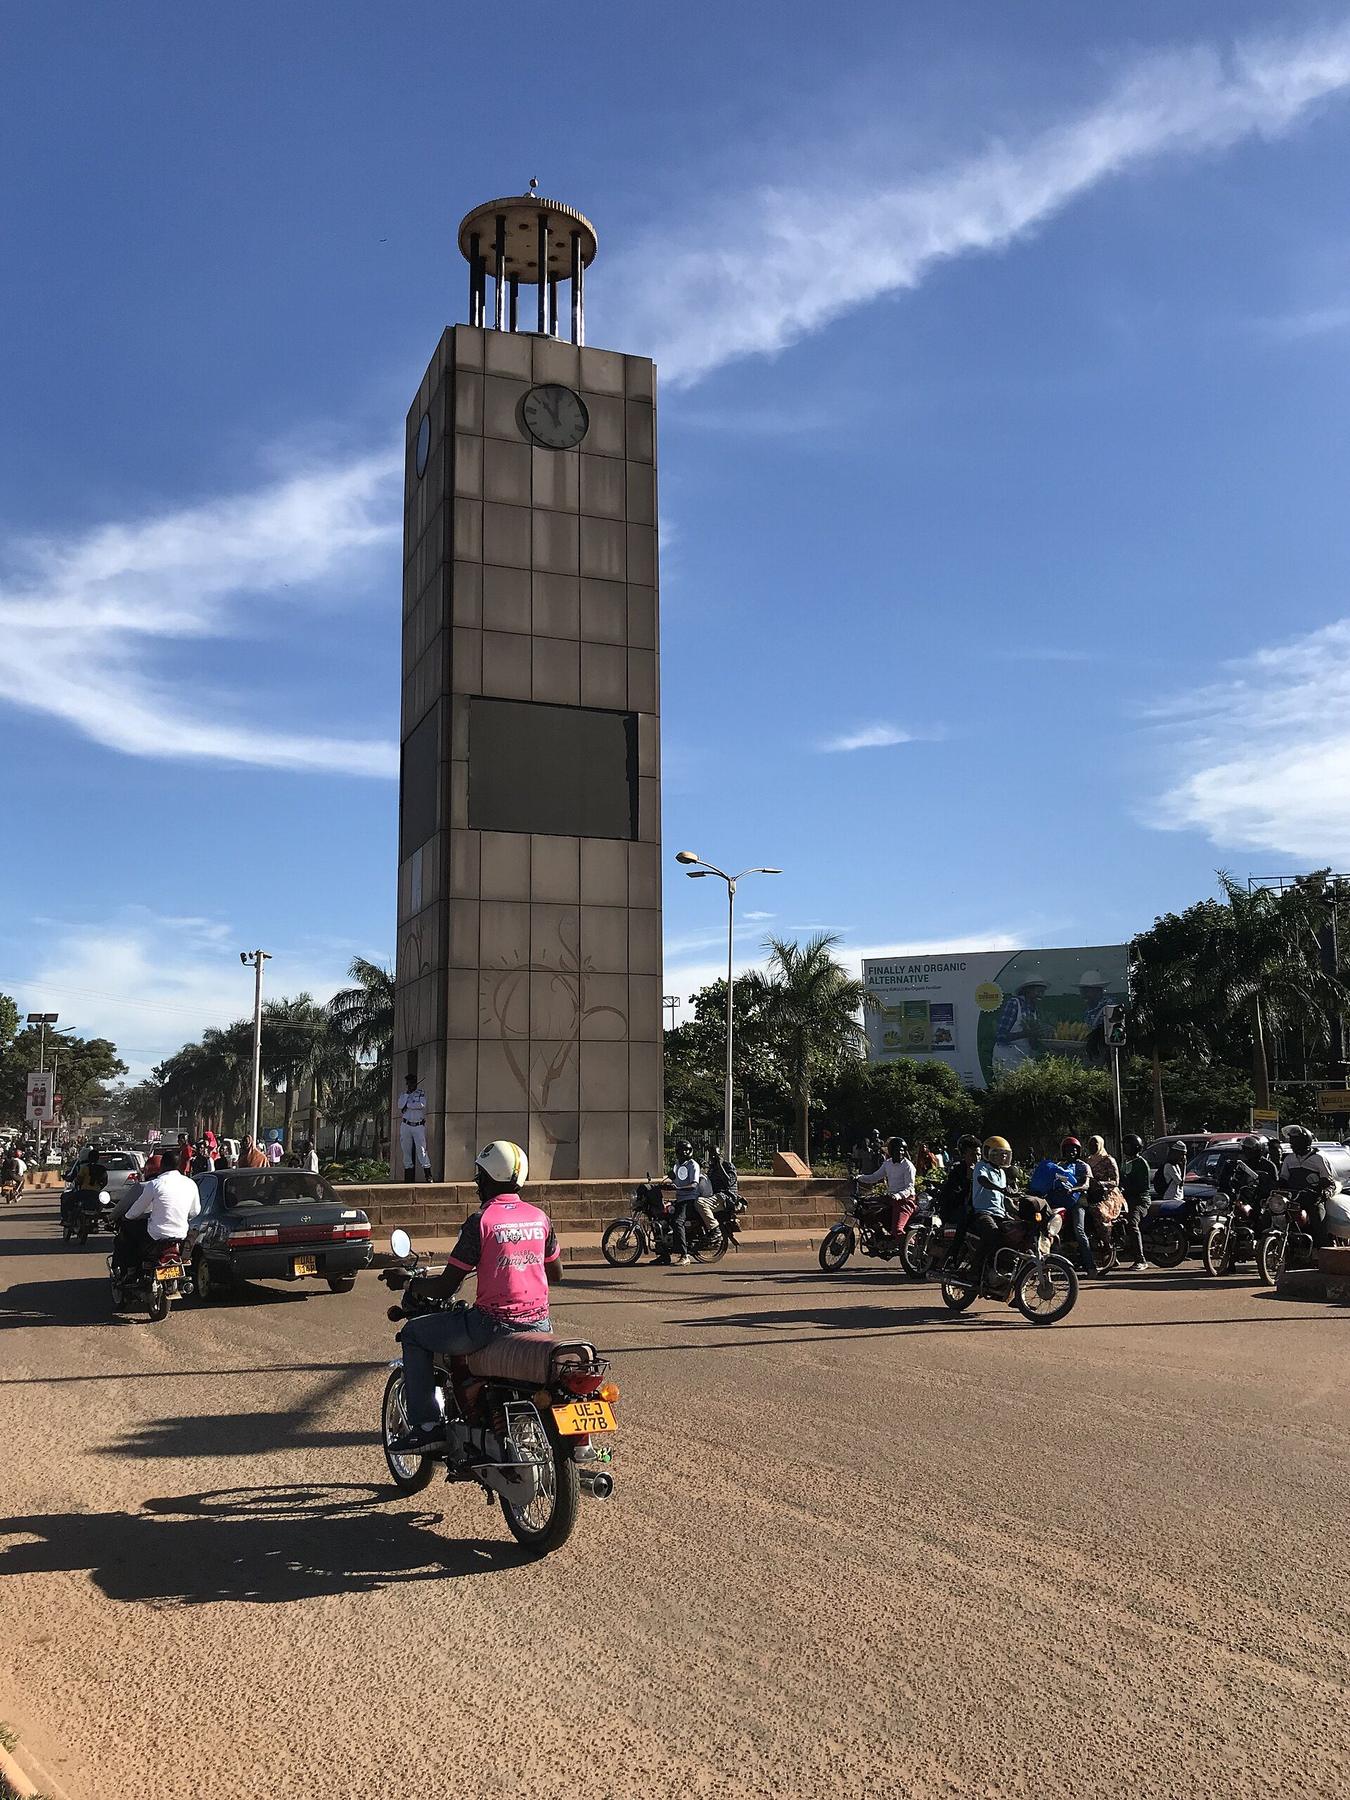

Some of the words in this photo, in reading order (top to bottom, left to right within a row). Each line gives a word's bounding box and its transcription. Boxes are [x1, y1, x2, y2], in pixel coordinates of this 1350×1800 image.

[868, 965, 905, 975] FINALLY
[908, 965, 921, 974] AN
[923, 962, 967, 973] ORGANIC
[868, 974, 929, 985] ALTERNATIVE
[574, 1402, 603, 1416] UEJ
[572, 1417, 608, 1431] 177B
